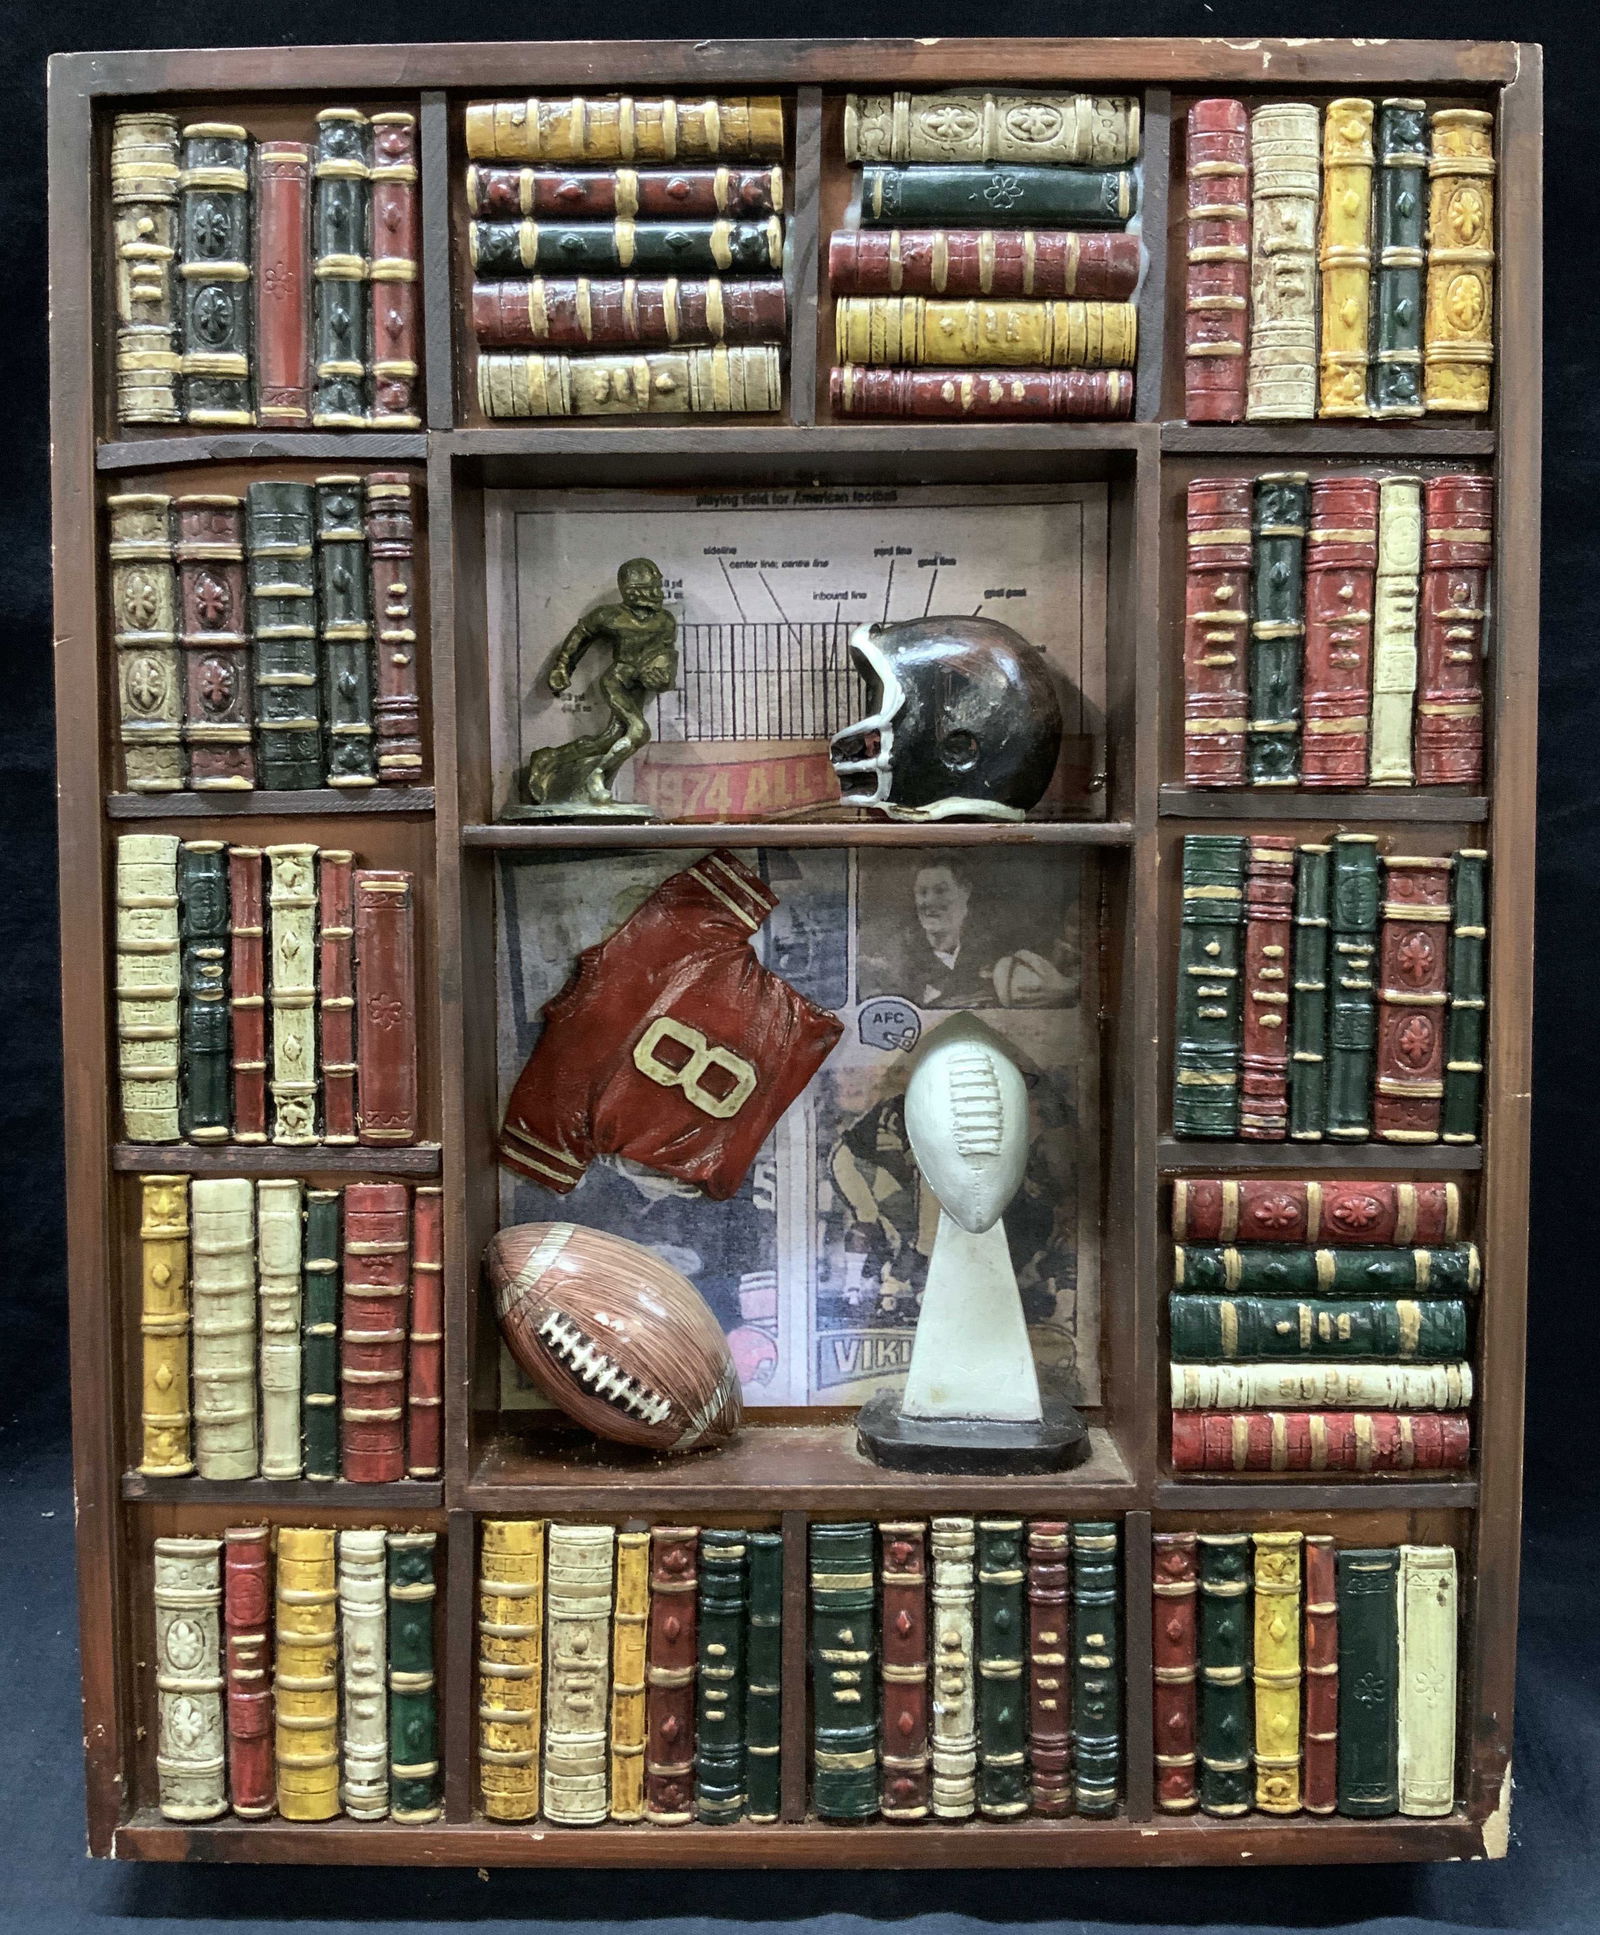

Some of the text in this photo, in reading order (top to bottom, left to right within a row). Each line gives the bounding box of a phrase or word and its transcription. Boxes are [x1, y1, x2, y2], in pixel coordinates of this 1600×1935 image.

[729, 560, 757, 570] center
[812, 558, 829, 569] line
[813, 591, 867, 601] inbound line
[646, 770, 732, 822] 1974
[872, 1012, 905, 1025] AFC
[632, 1016, 758, 1119] 8
[833, 1338, 912, 1373] VIKI
